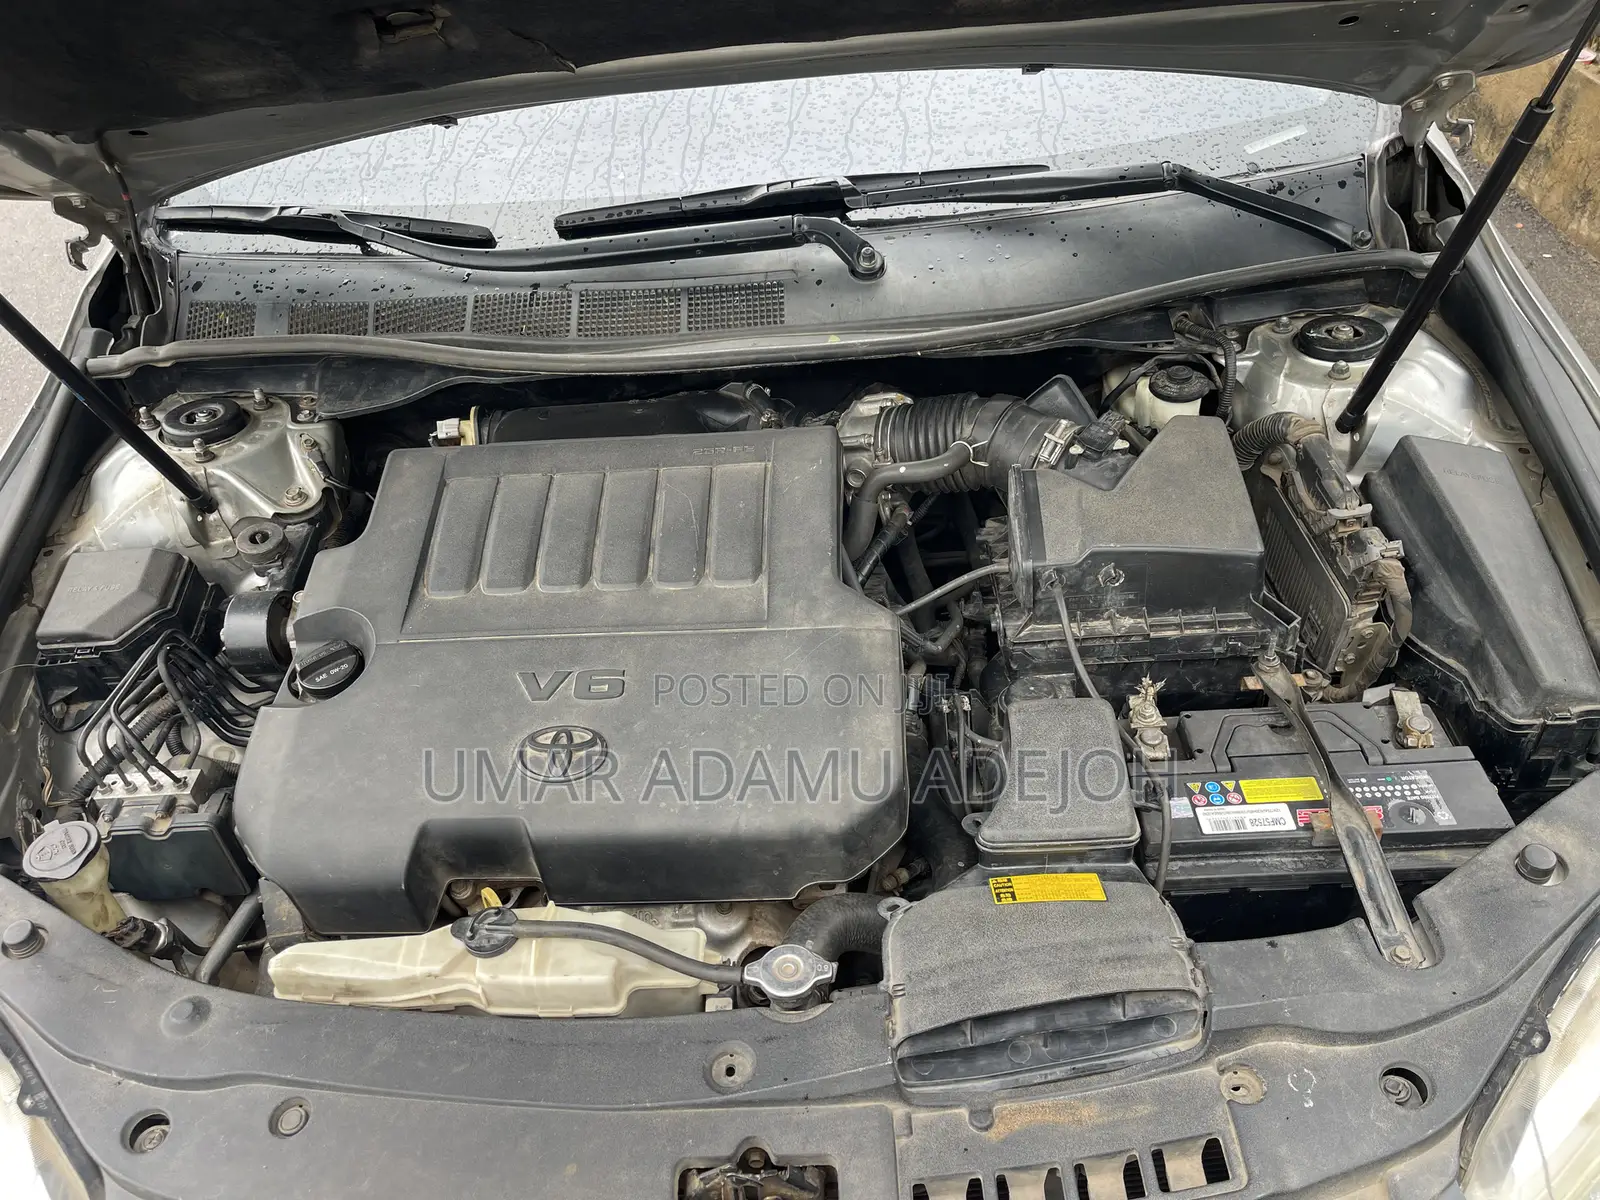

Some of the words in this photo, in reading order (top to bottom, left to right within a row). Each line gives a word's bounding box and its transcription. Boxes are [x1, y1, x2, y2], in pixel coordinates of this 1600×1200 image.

[315, 672, 329, 683] SAE
[516, 668, 627, 702] V6
[1249, 816, 1287, 828] CMF57528
